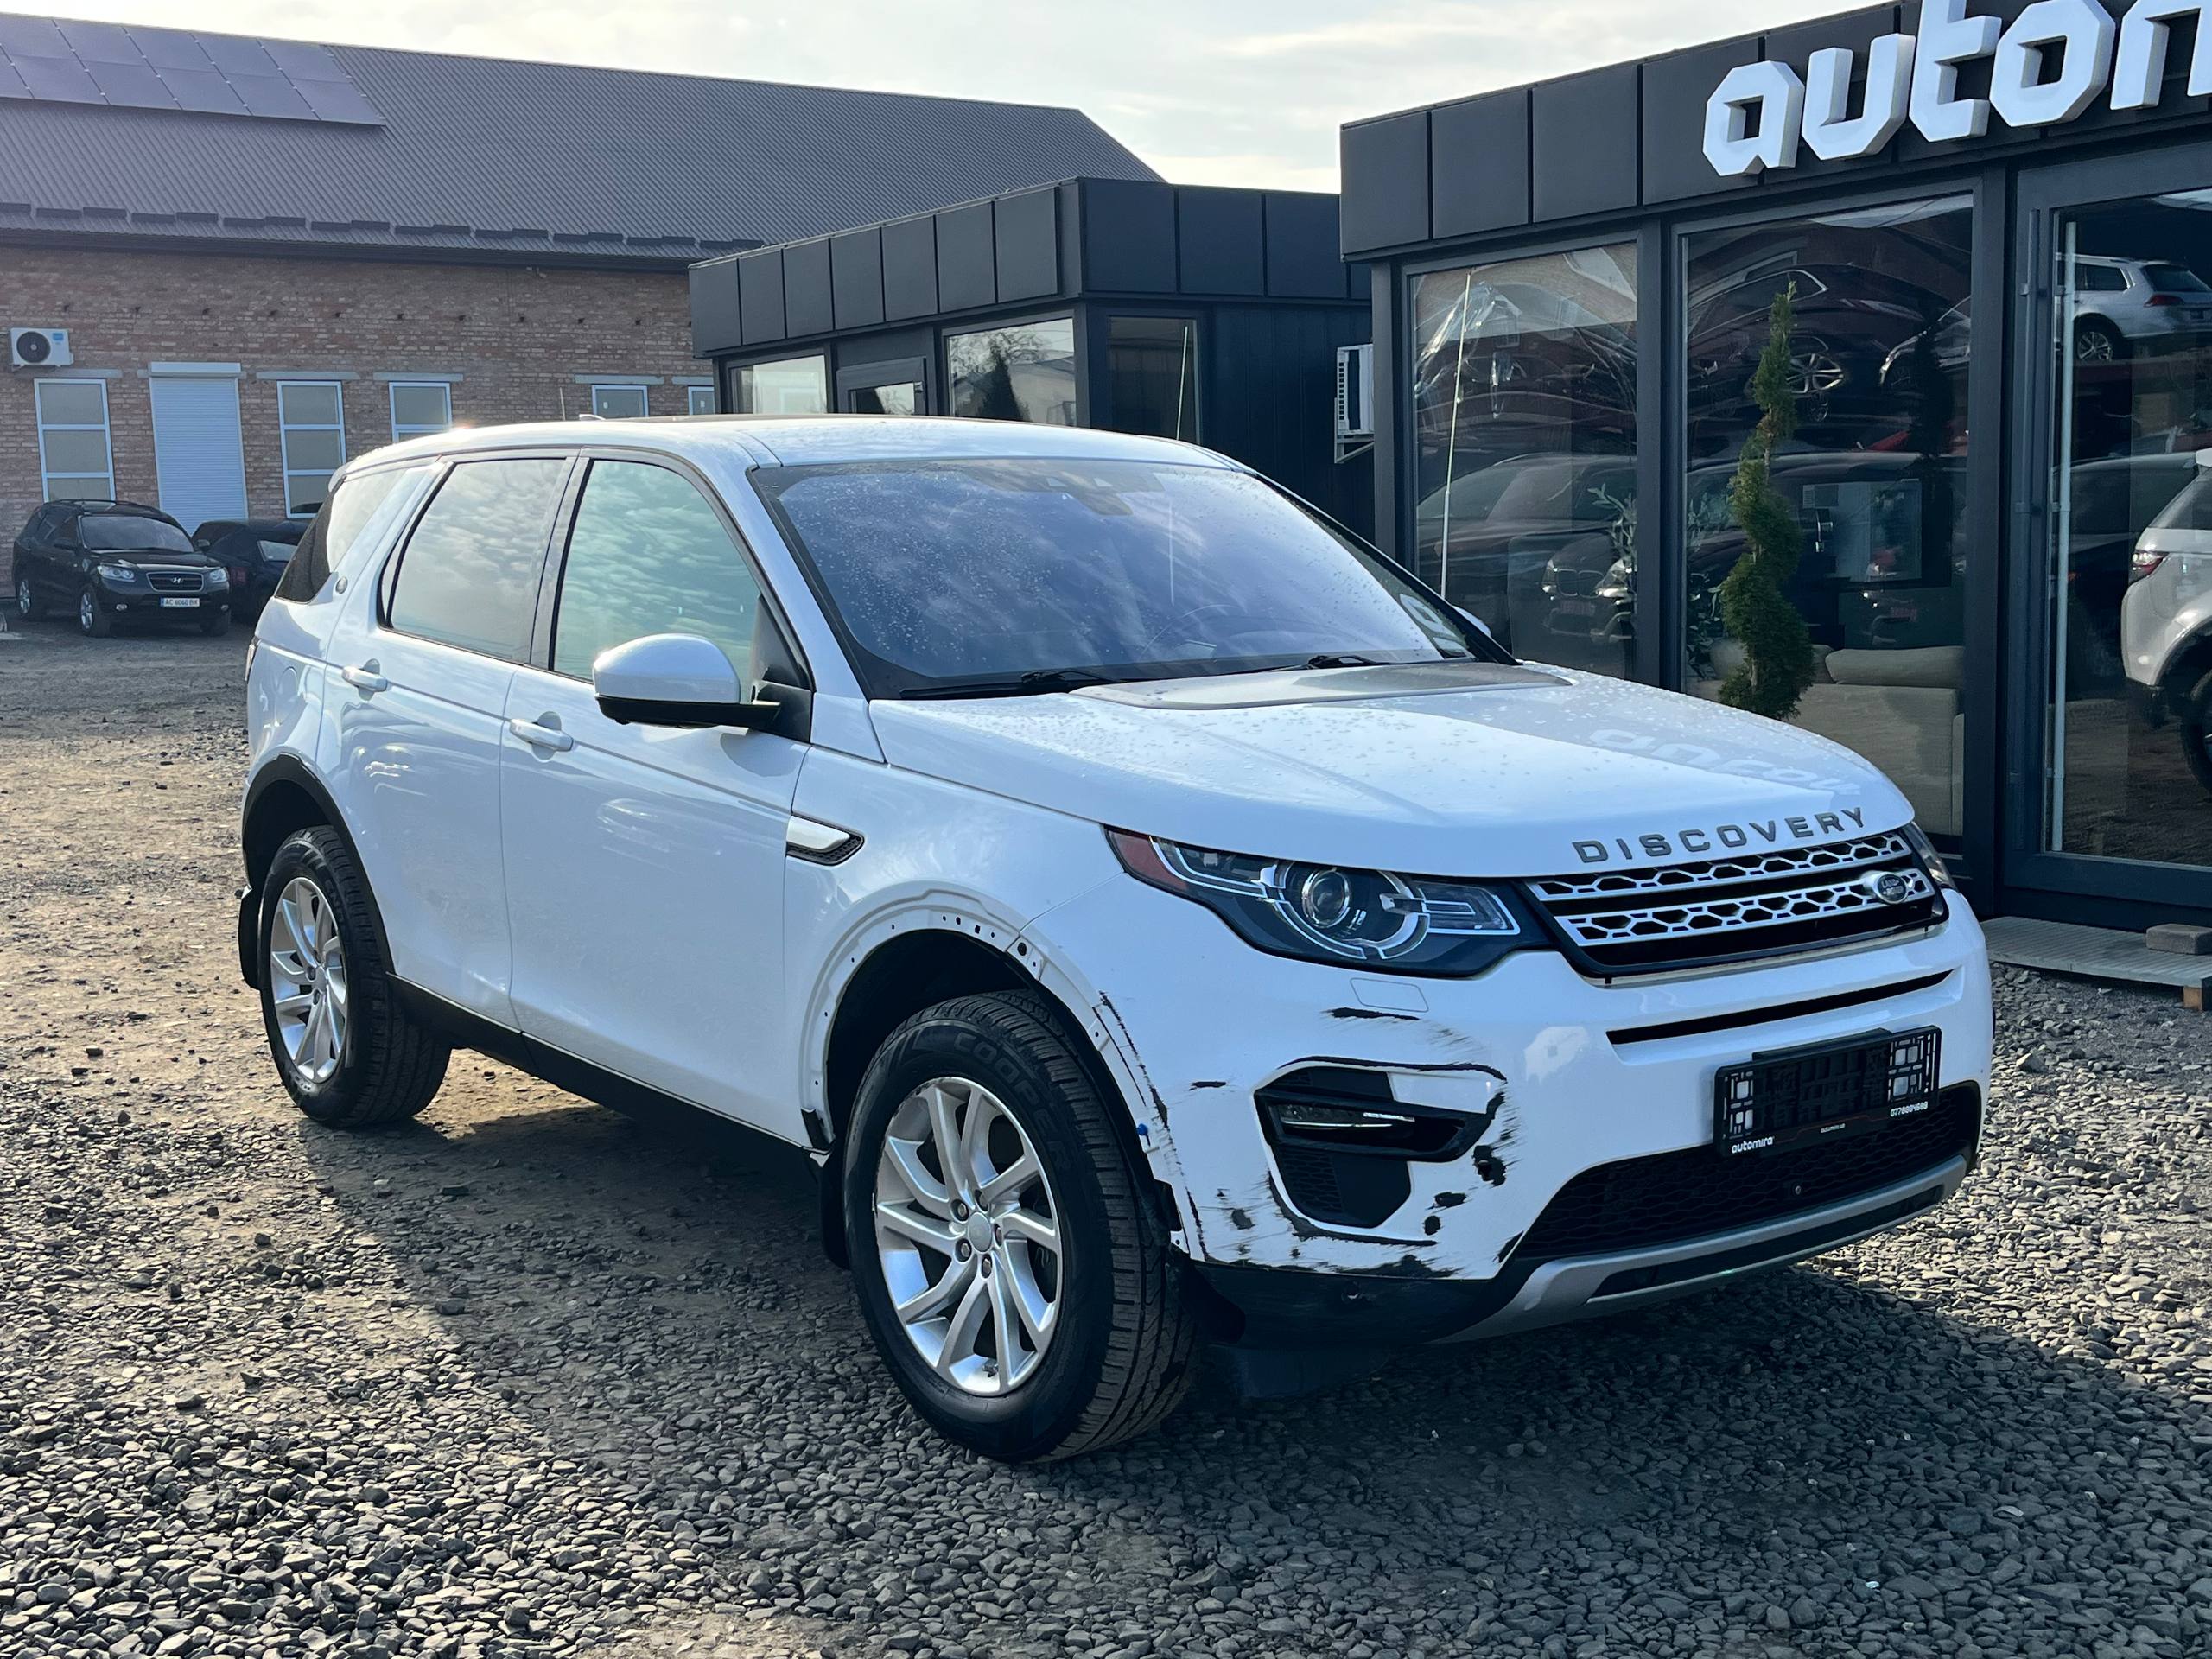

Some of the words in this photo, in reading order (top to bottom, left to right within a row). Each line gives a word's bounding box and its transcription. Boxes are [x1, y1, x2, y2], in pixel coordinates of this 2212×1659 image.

[1571, 807, 1865, 864] DISCOVERY
[954, 1031, 1074, 1173] COOPER
[1732, 1136, 1774, 1154] automira
